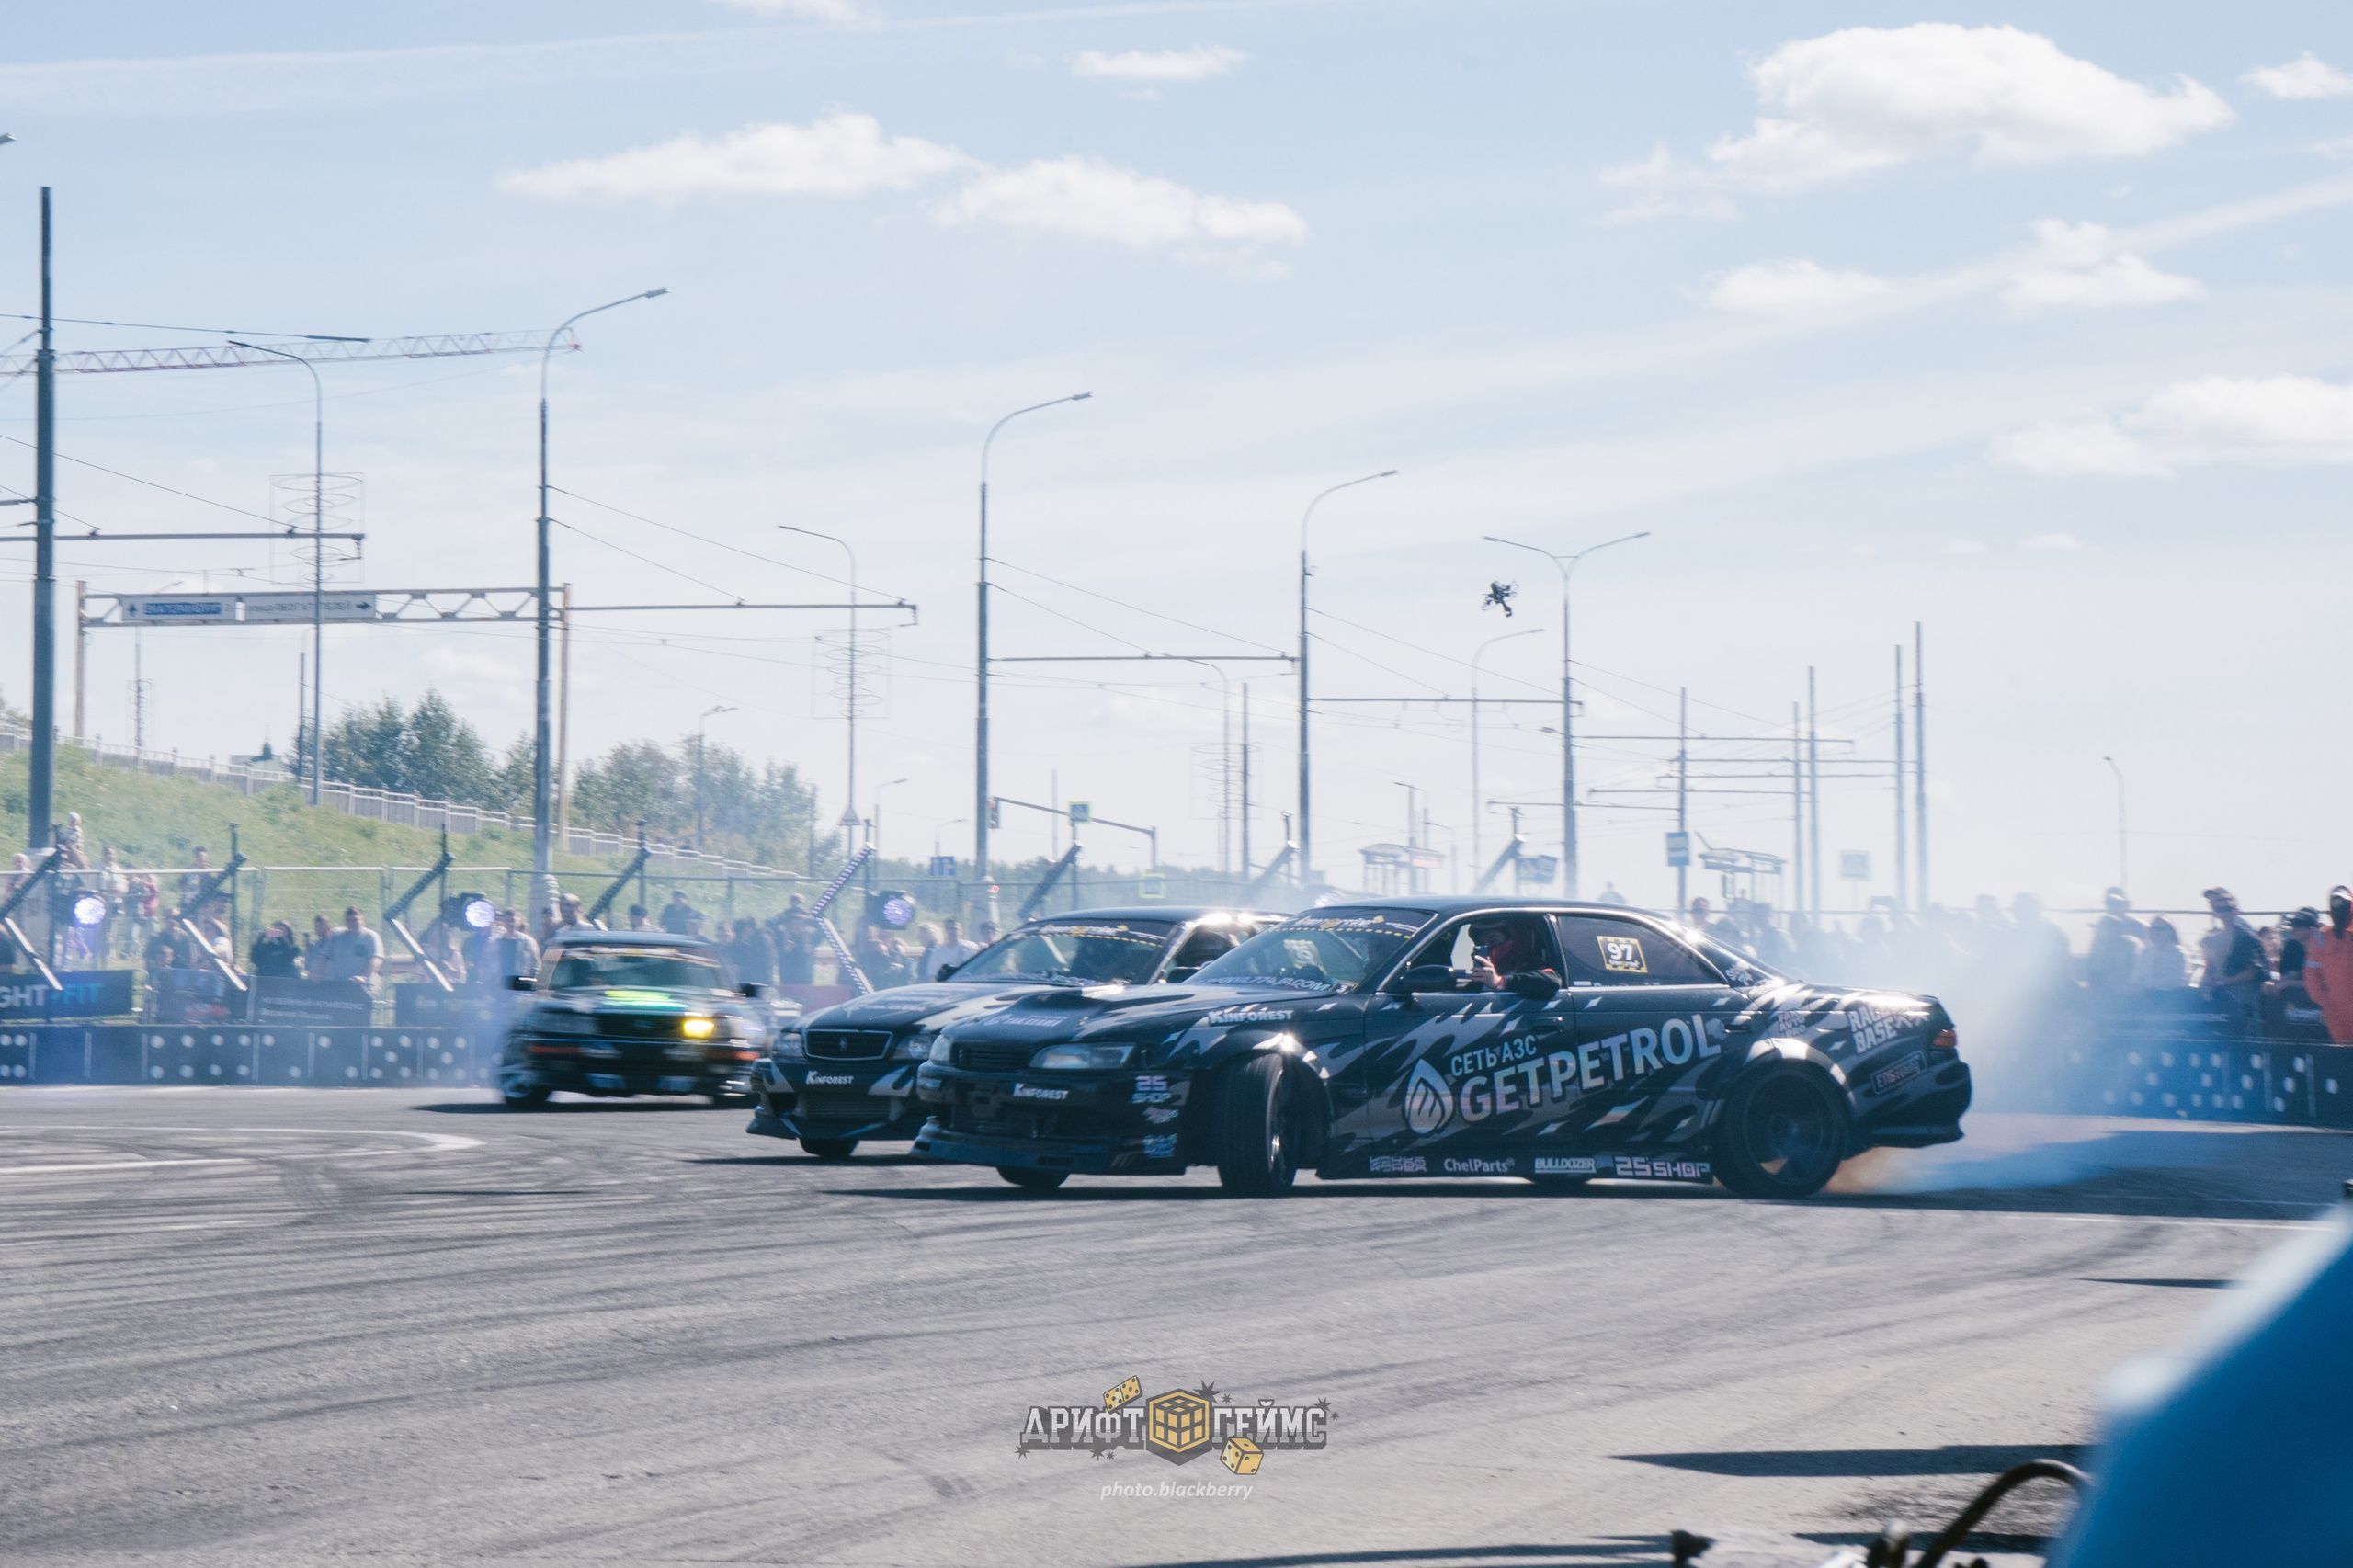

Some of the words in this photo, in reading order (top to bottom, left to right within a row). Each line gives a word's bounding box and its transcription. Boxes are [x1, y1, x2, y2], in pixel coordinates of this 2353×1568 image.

[1607, 942, 1632, 961] 97
[1208, 1009, 1294, 1025] KINFOREST
[1854, 1016, 1897, 1054] BASE
[1450, 1048, 1497, 1077] СЕТЬ
[1501, 1034, 1537, 1063] АЗС
[1460, 1014, 1721, 1123] GETPETROL
[1135, 1075, 1168, 1092] 25
[1535, 1157, 1597, 1172] BULLDOZER
